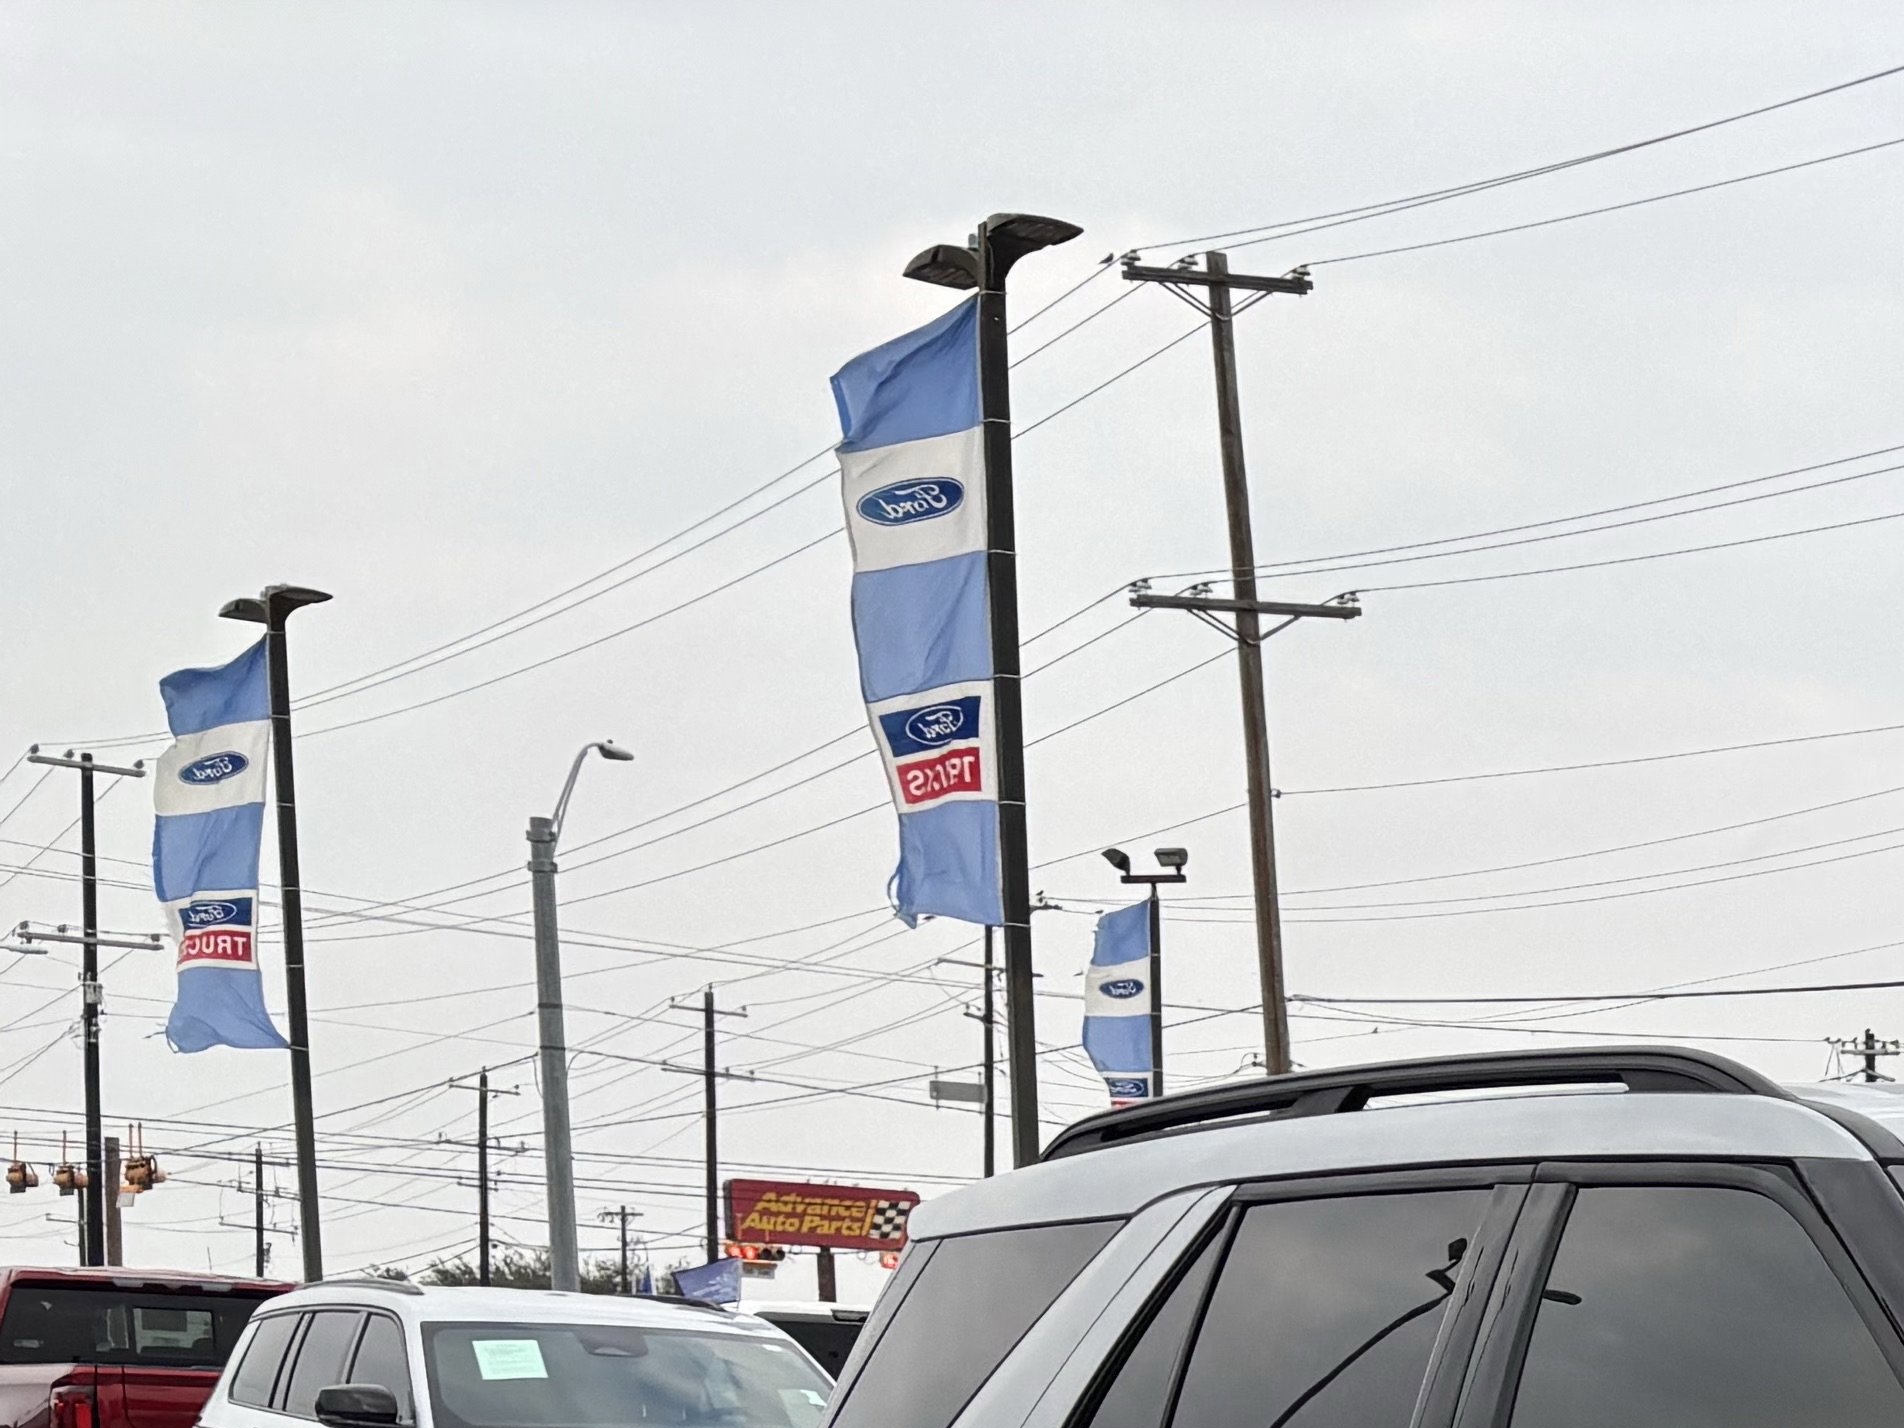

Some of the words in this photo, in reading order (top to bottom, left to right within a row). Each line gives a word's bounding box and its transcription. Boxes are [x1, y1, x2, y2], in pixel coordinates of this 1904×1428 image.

[754, 1192, 867, 1217] Advance
[741, 1212, 800, 1232] Auto
[801, 1215, 863, 1236] Parts
